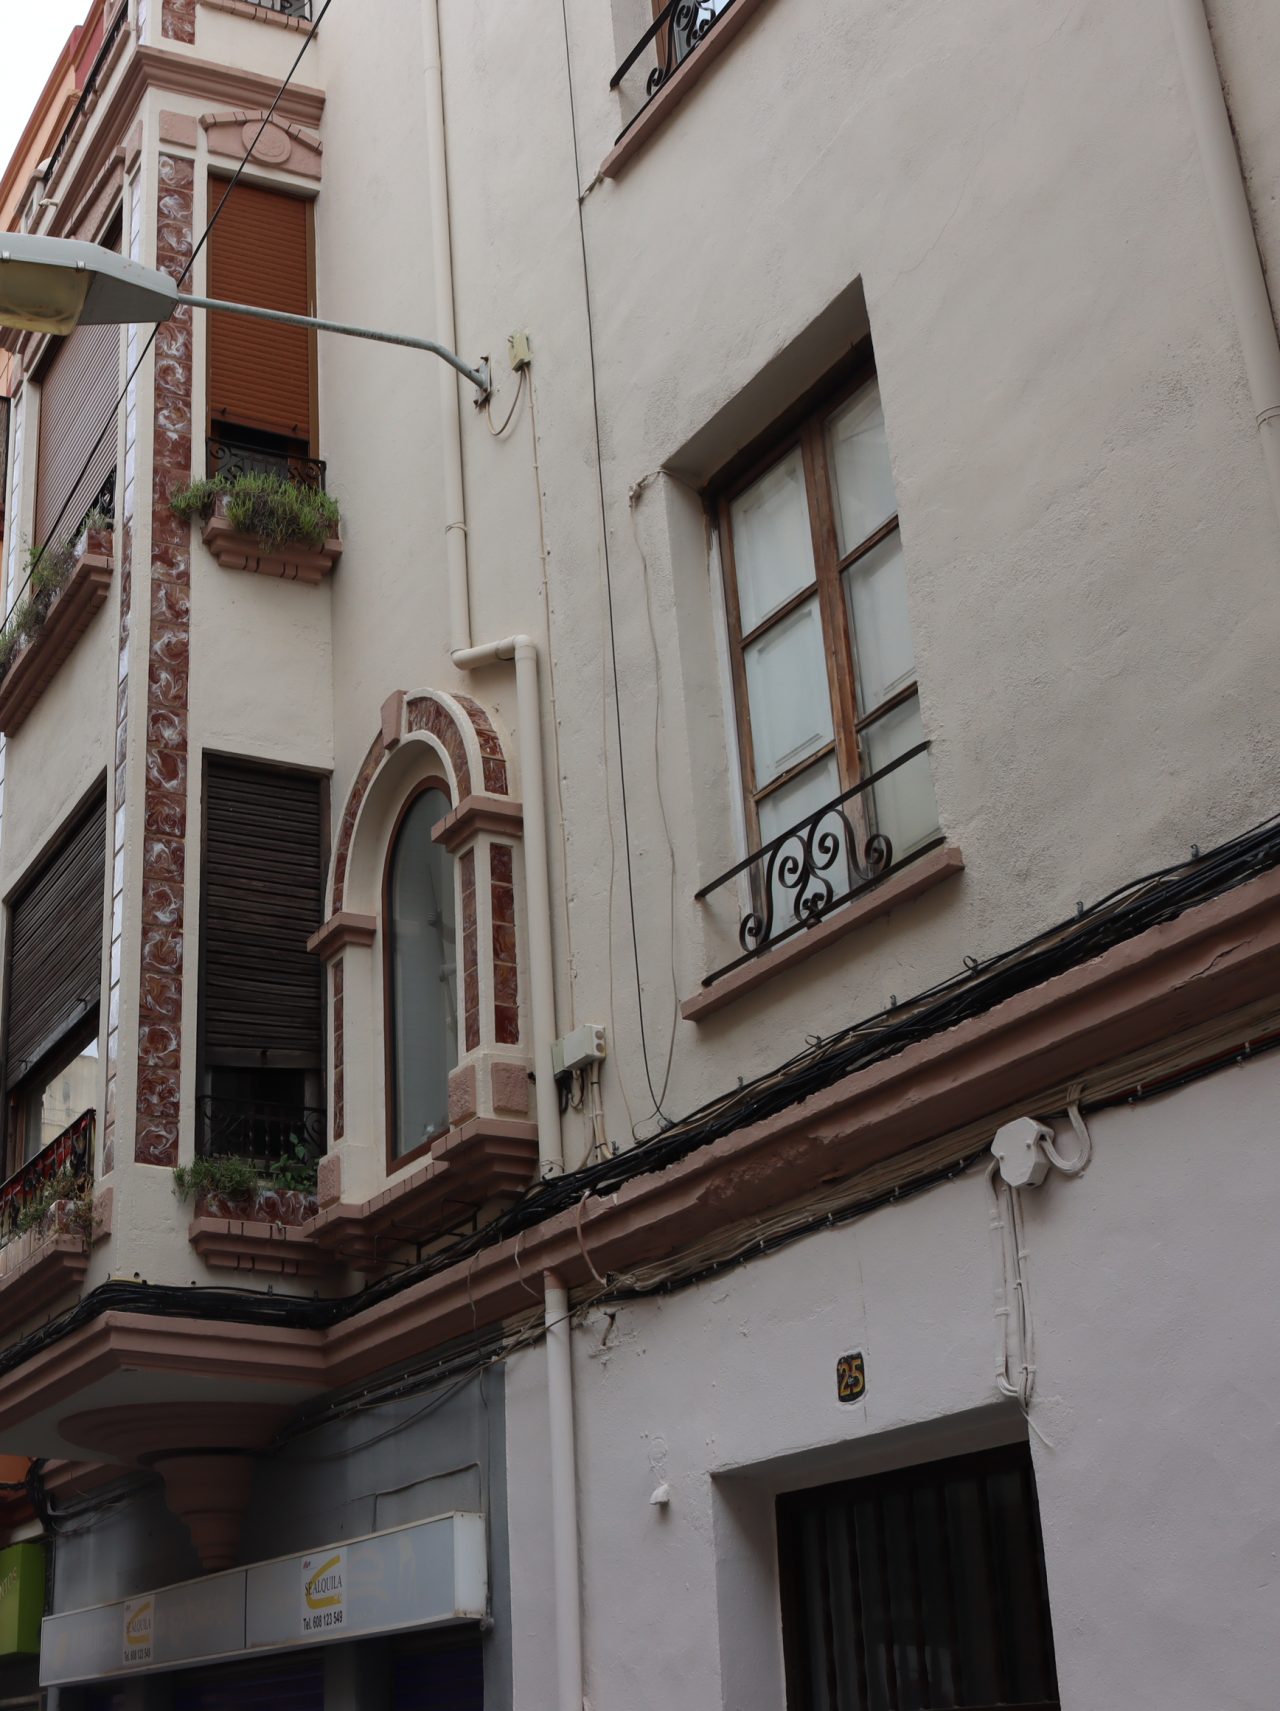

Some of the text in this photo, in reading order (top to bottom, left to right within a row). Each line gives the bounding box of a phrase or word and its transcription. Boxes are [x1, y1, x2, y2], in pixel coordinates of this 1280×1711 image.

[838, 1359, 863, 1396] 25
[313, 1575, 342, 1595] ALQUILA
[303, 1610, 343, 1631] Tel. 608 123 549
